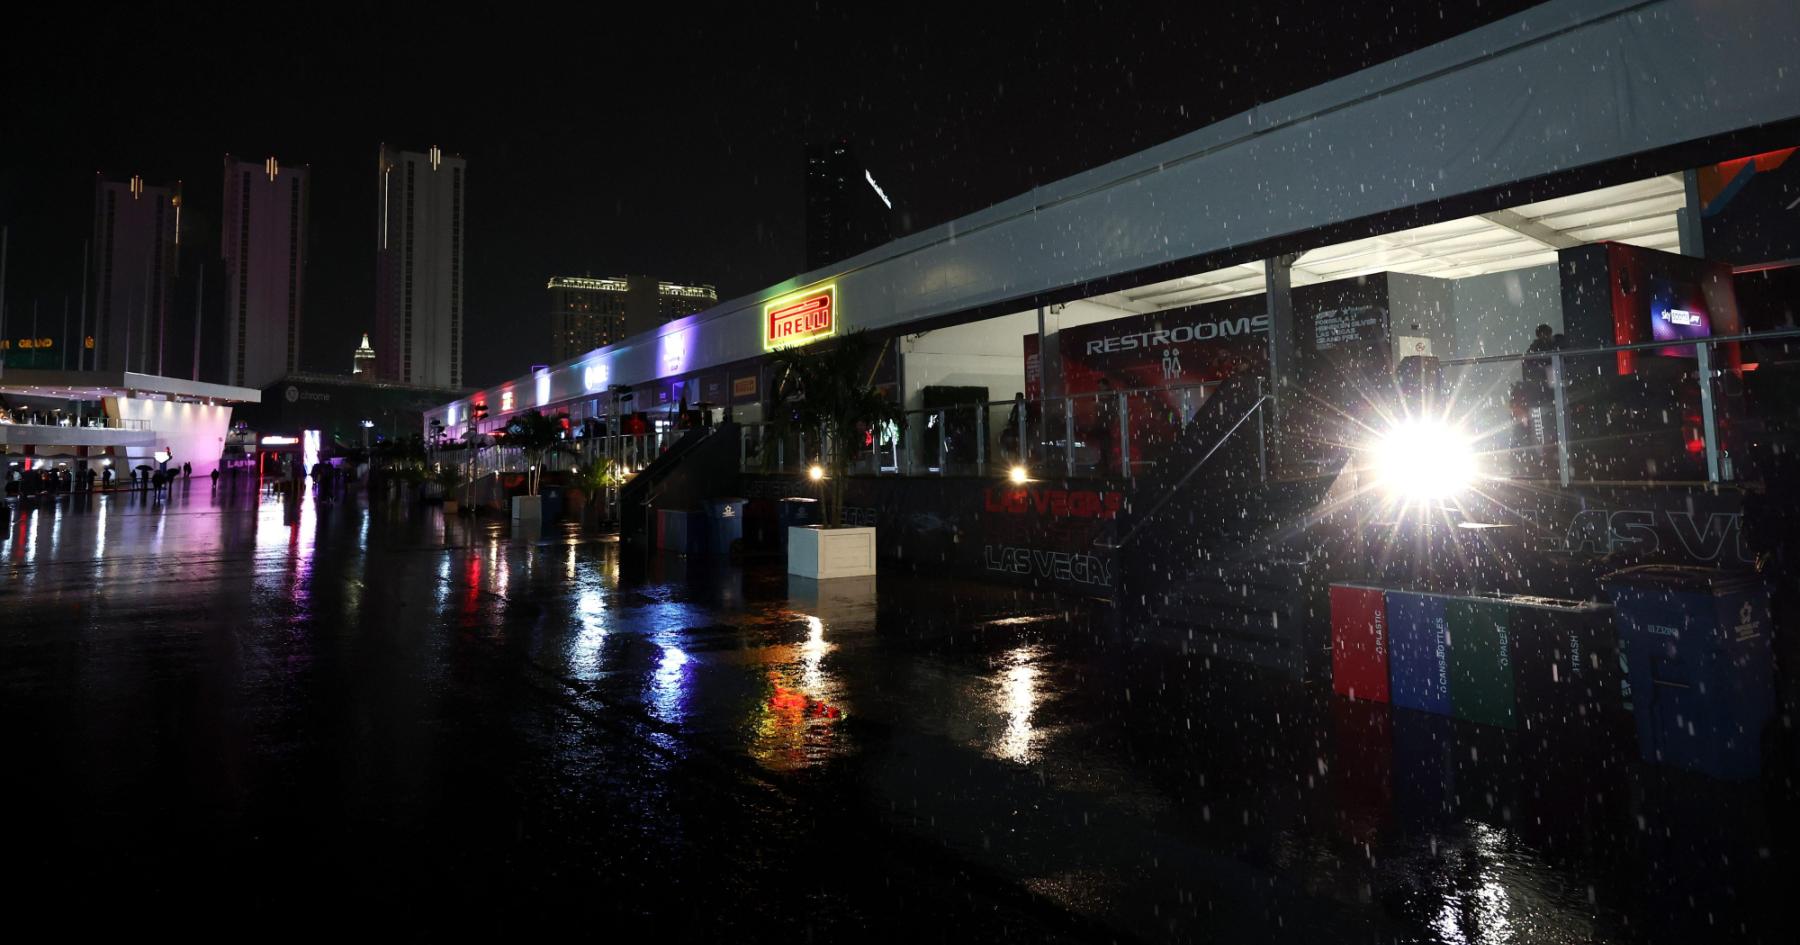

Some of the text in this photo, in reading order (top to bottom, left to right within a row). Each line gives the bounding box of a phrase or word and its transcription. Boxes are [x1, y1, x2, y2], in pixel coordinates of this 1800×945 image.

[769, 295, 829, 341] PIRELLI
[1087, 314, 1270, 356] RESTROOMS
[1520, 509, 1660, 553] LAS
[985, 545, 1032, 574] LAS
[1375, 609, 1384, 647] PLASTIC
[1500, 626, 1508, 658] PAPER
[1570, 635, 1580, 668] TRASH
